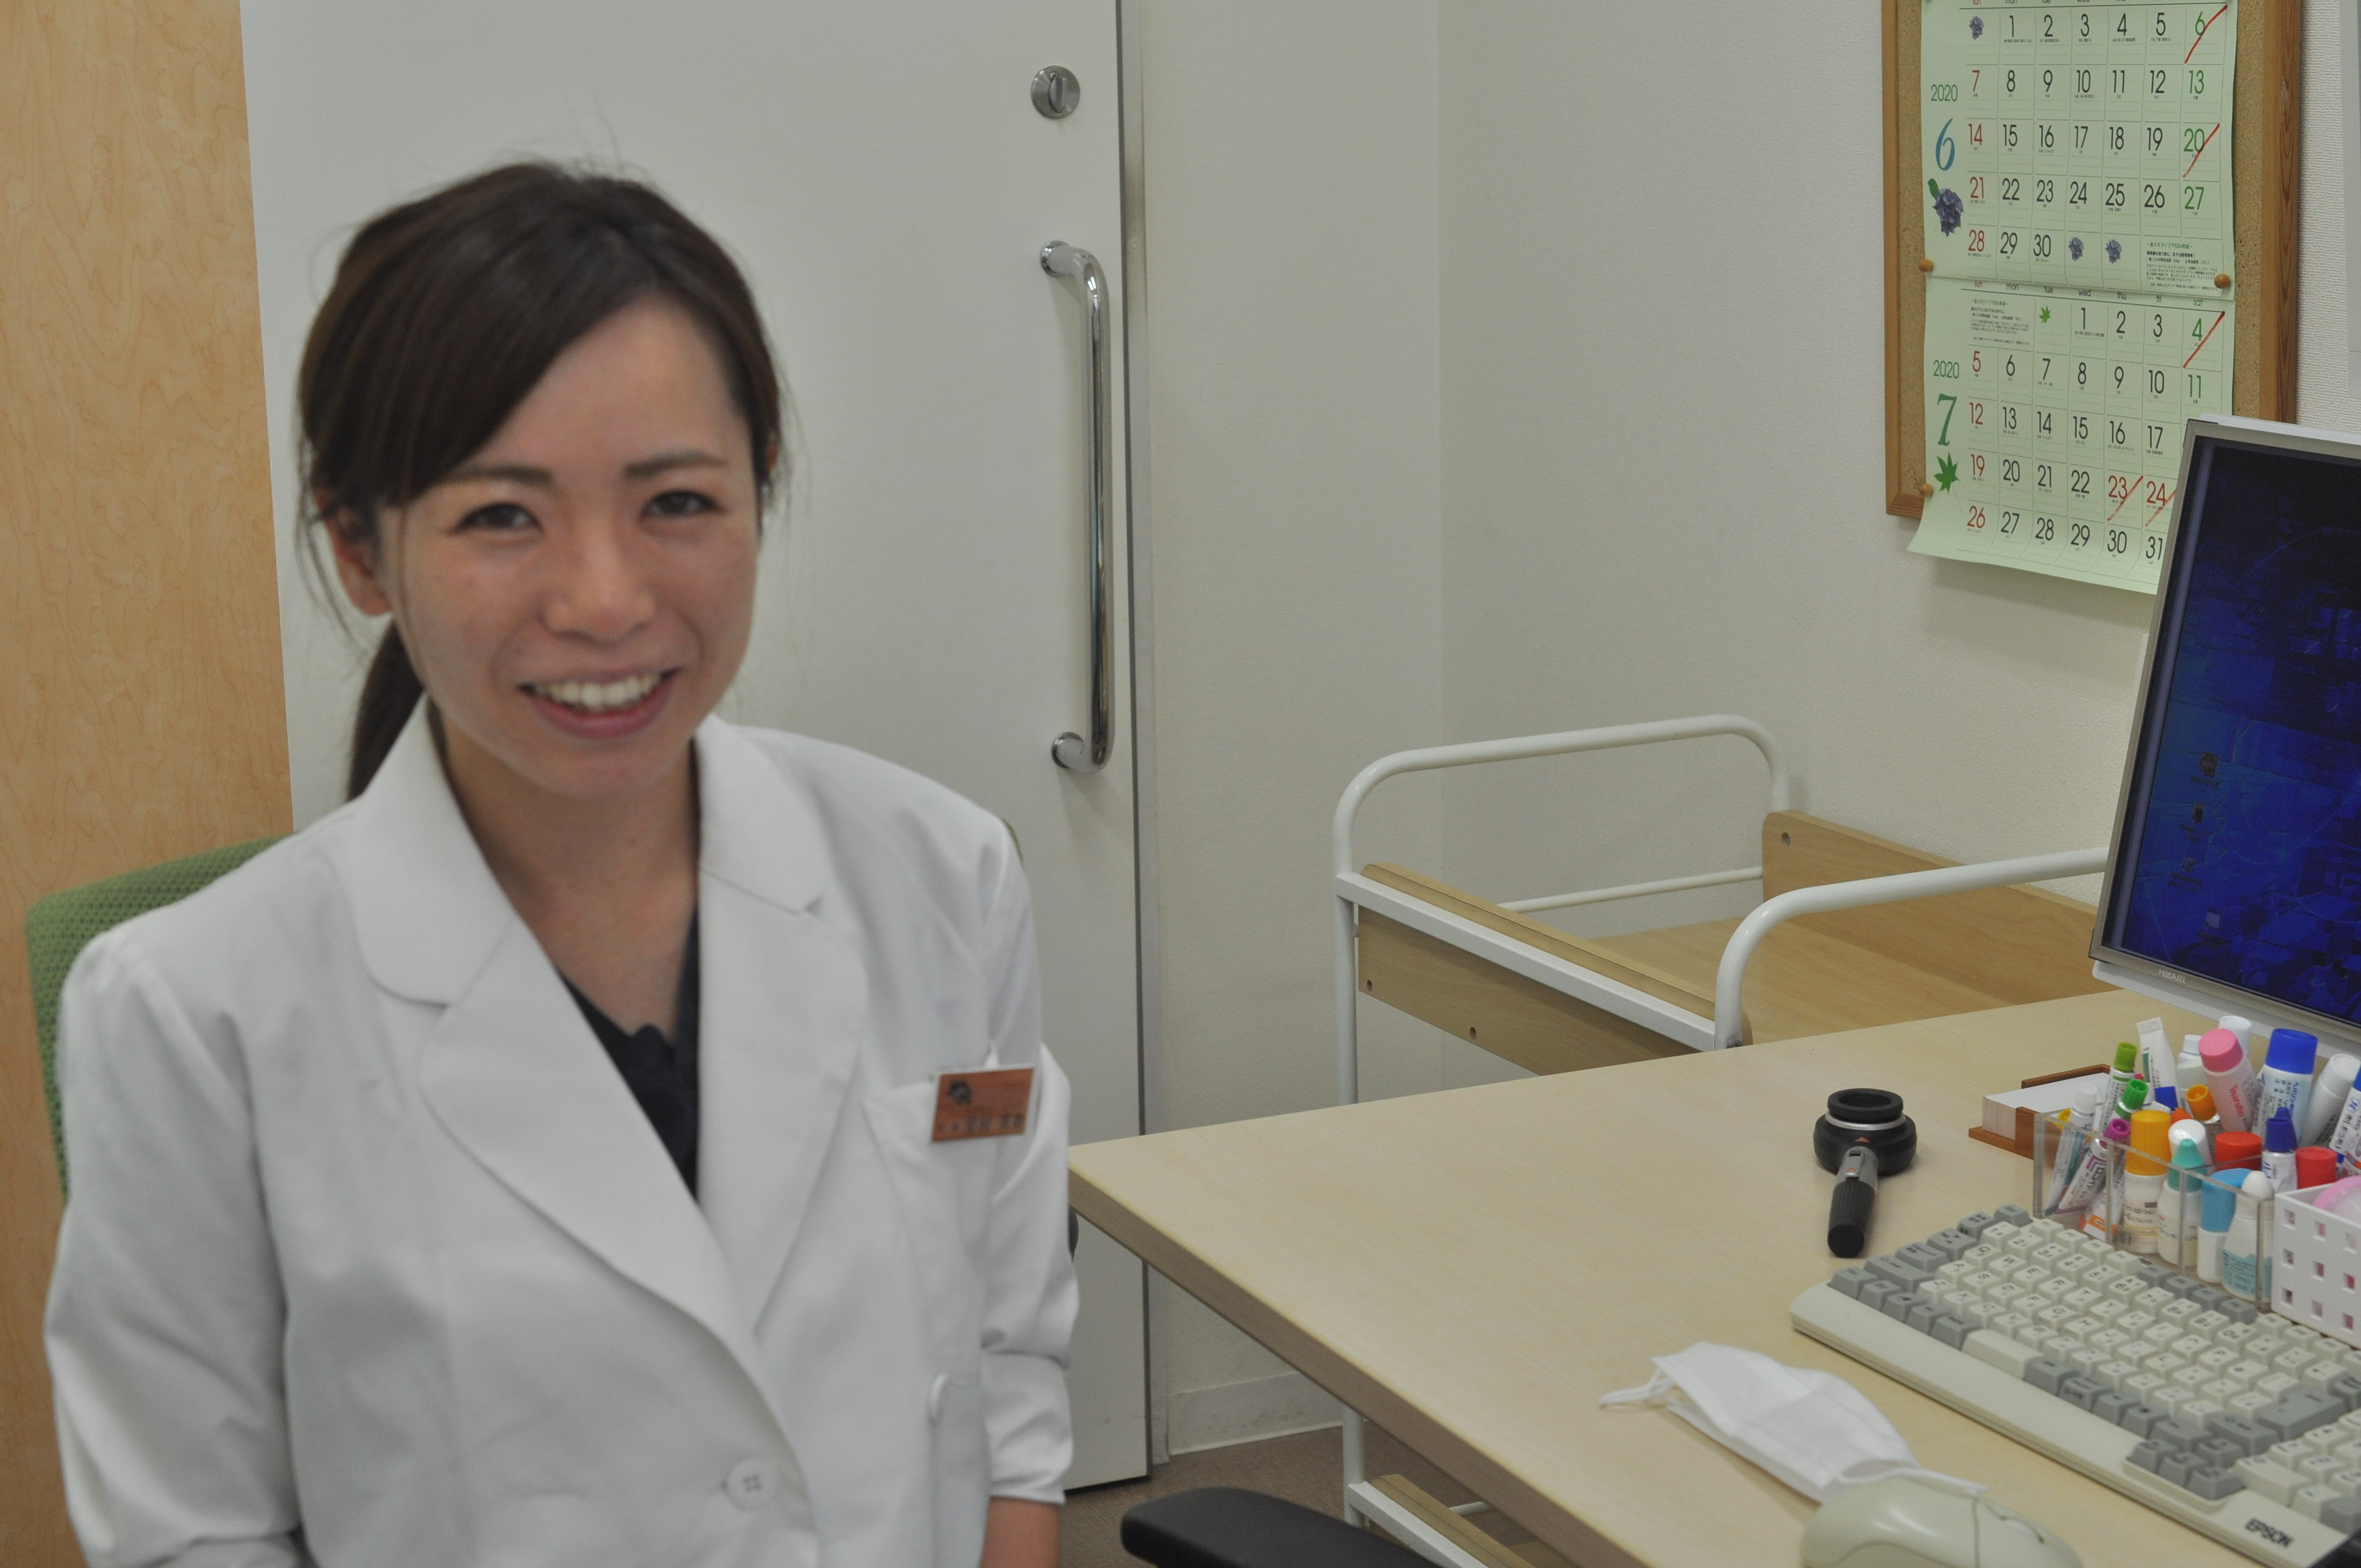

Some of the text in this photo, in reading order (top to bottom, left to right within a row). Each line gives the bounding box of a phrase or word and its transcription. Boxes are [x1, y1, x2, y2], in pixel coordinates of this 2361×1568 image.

[2009, 12, 2205, 37] 1 2 3 4 5 6
[1930, 84, 1958, 102] 2020
[1972, 69, 2205, 95] 7 8 9 10 11 12 13
[1935, 118, 1955, 171] 6
[1968, 123, 2204, 153] 14 15 16 17 18 19 20
[1970, 176, 2205, 210] 21 22 23 24 25 26 27
[1968, 229, 2052, 258] 28 29 30
[2117, 291, 2126, 300] thu
[2081, 307, 2203, 341] 1 2 3 4
[1933, 360, 1960, 379] 2020
[1972, 350, 2201, 399] 5 6 7 8 9 10 11
[1937, 393, 1957, 447] 7
[1970, 402, 2163, 449] 12 13 14 15 16 17
[1971, 454, 2167, 505] 19 20 21 22 23 24
[1967, 505, 2163, 560] 26 27 28 29 30 31
[2245, 1517, 2294, 1547] EPSON
